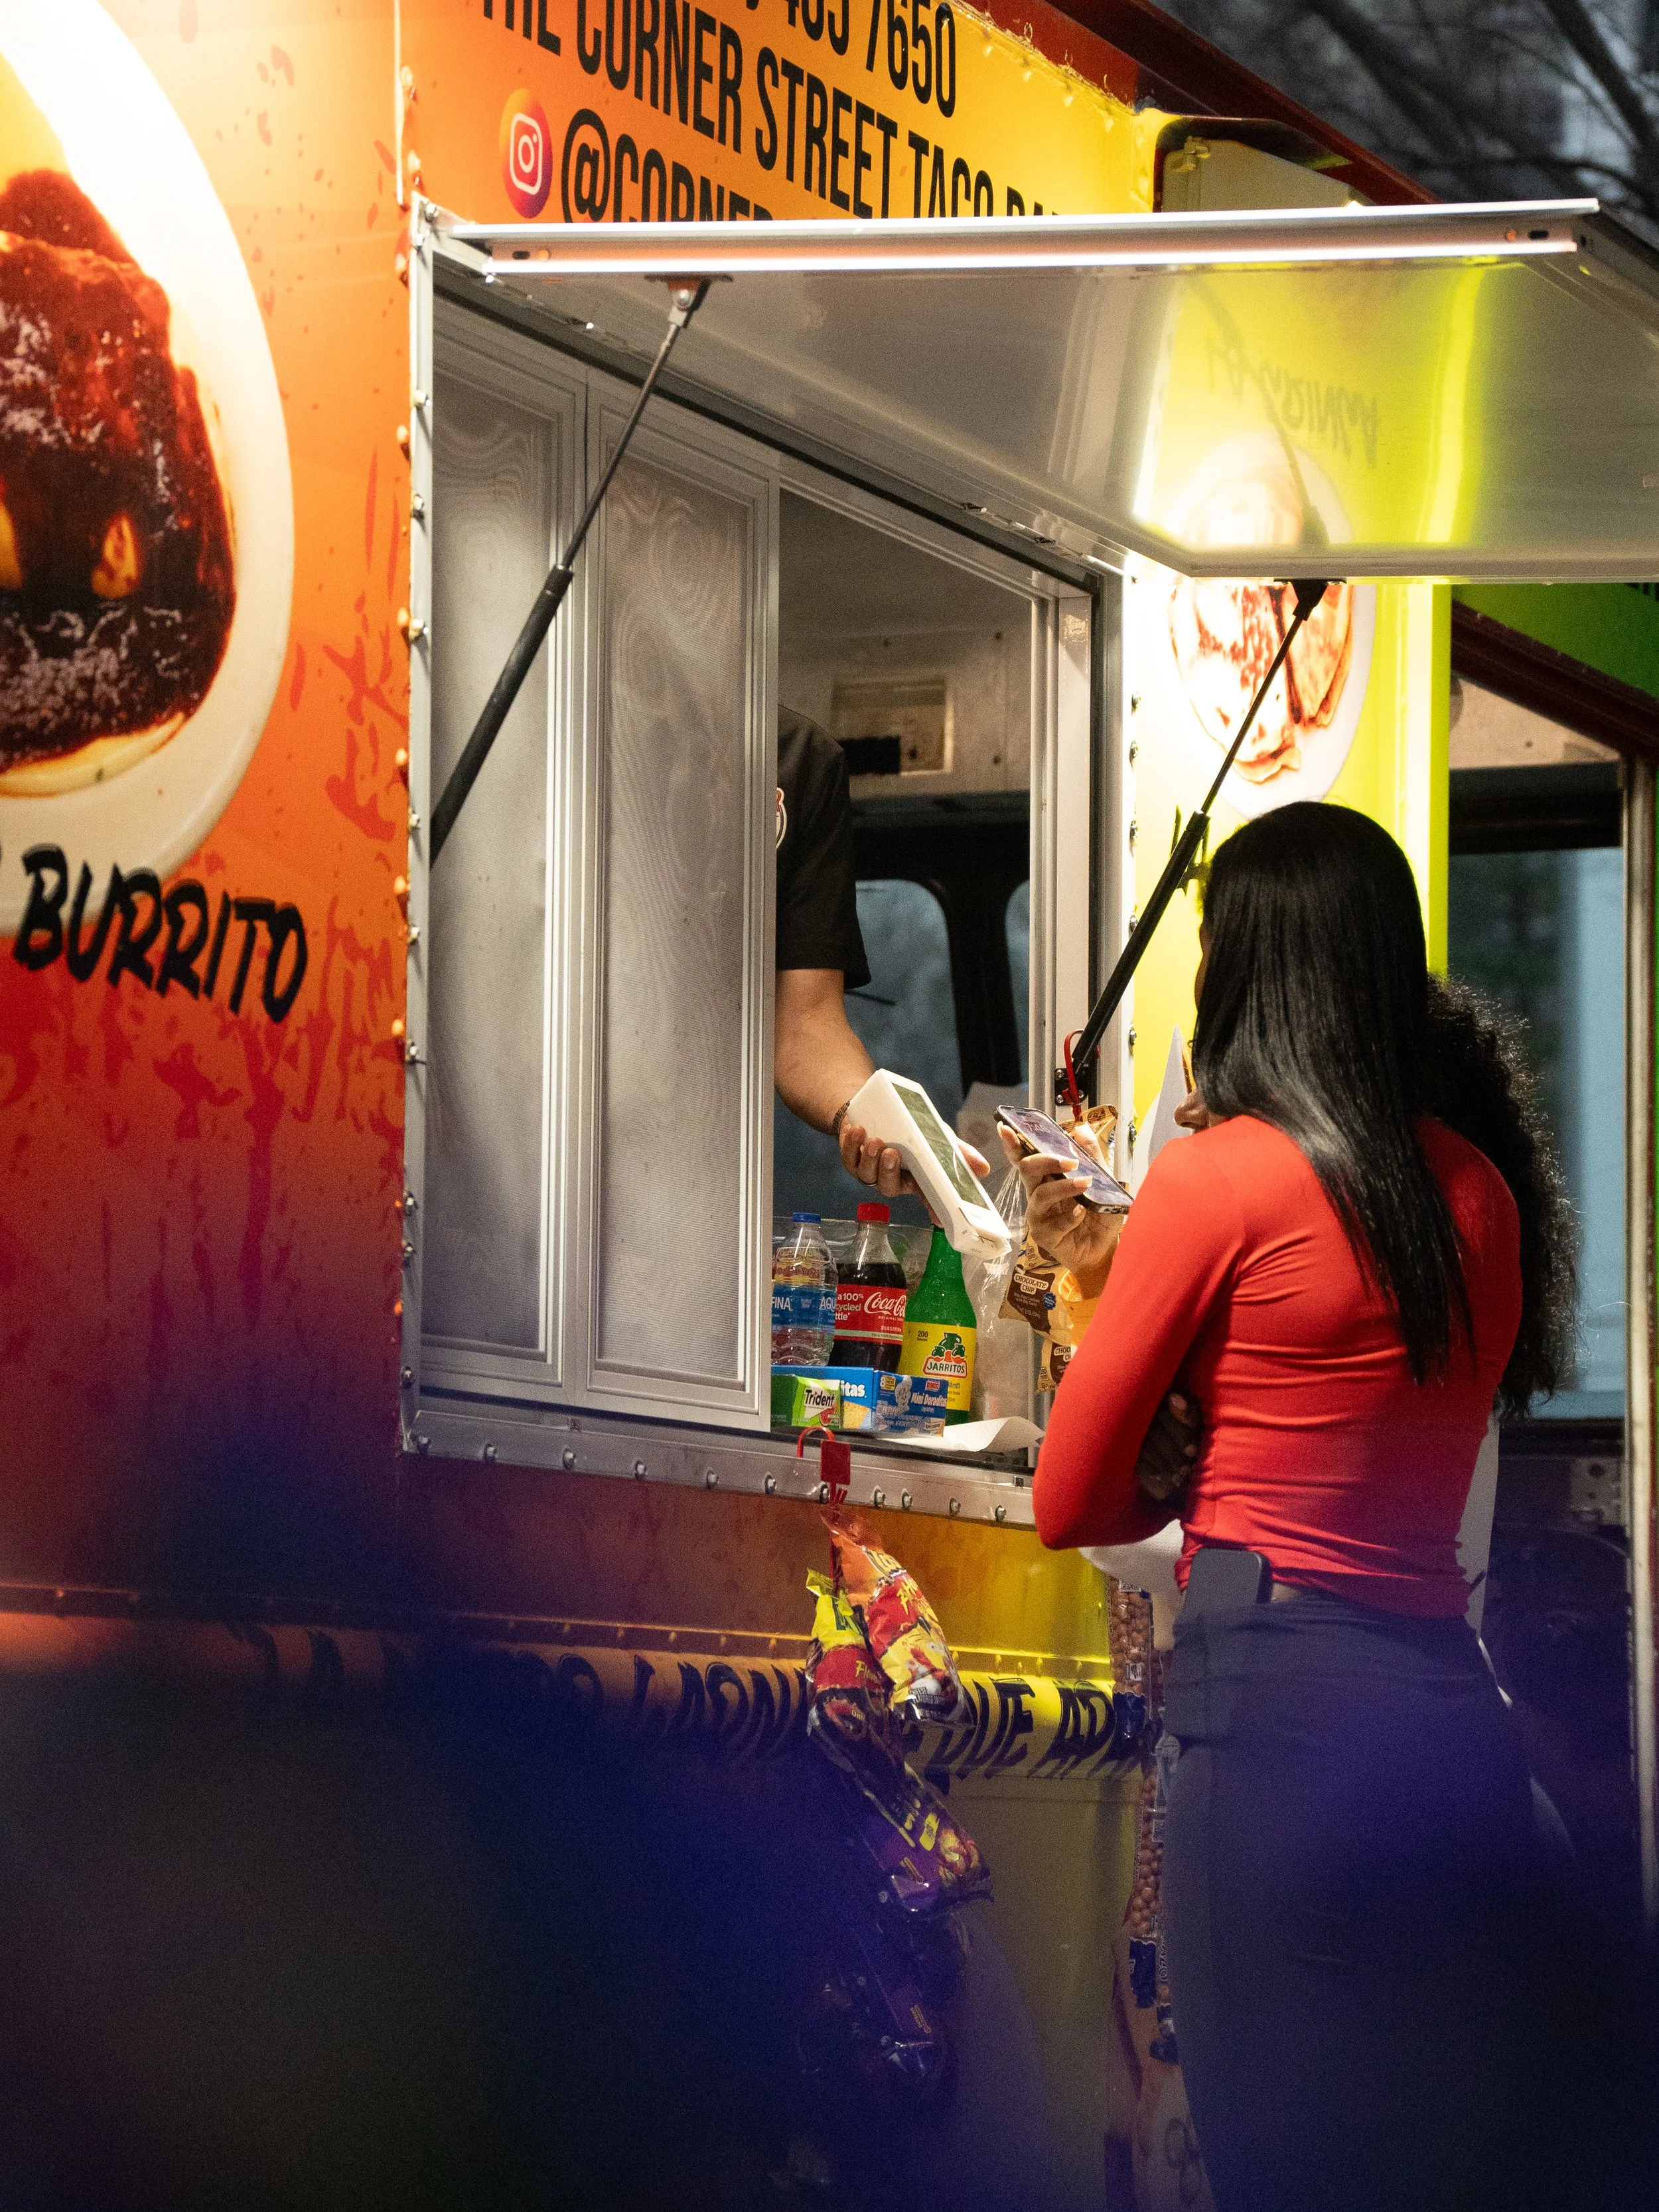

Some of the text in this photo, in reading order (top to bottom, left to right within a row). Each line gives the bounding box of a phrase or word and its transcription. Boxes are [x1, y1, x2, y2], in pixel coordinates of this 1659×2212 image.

[577, 0, 742, 154] CORNER
[755, 46, 898, 220] STREET
[13, 843, 308, 1023] BURRITO
[1015, 1274, 1047, 1289] CHOCOLATE
[1022, 1284, 1035, 1293] CHIP
[926, 1362, 965, 1374] JARRITOS
[805, 1389, 835, 1407] Trident
